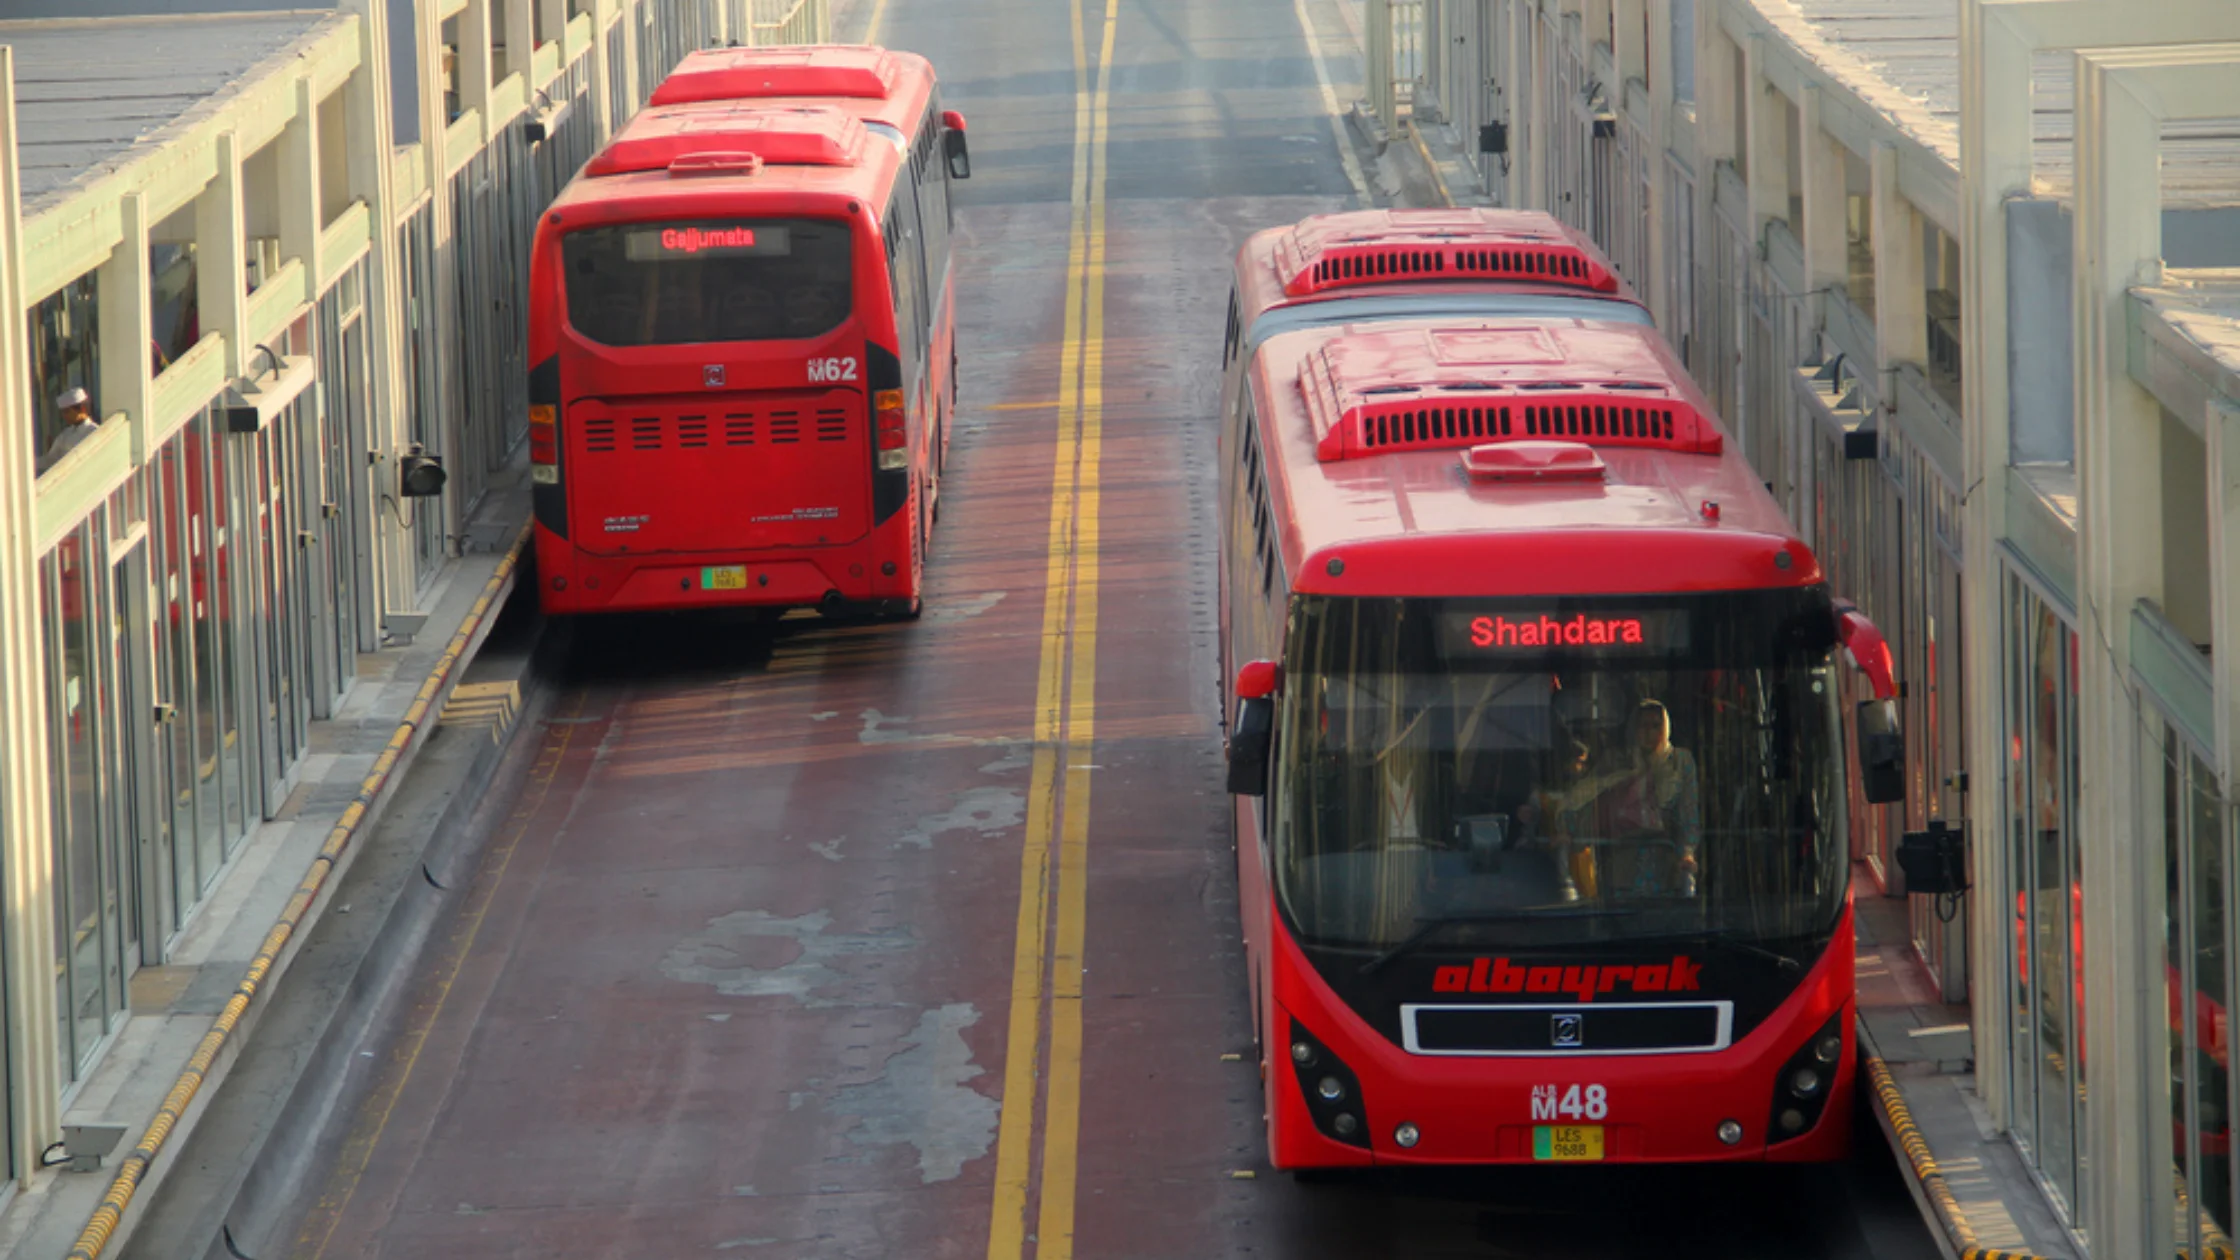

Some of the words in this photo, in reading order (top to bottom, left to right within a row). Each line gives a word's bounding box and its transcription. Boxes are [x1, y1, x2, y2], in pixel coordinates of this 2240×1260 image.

[662, 226, 754, 253] Gajjumata
[808, 357, 857, 382] M62
[1471, 614, 1643, 647] Shahdara
[1432, 956, 1702, 1003] albayrak
[1532, 1084, 1608, 1120] M48
[1556, 1128, 1582, 1142] LES
